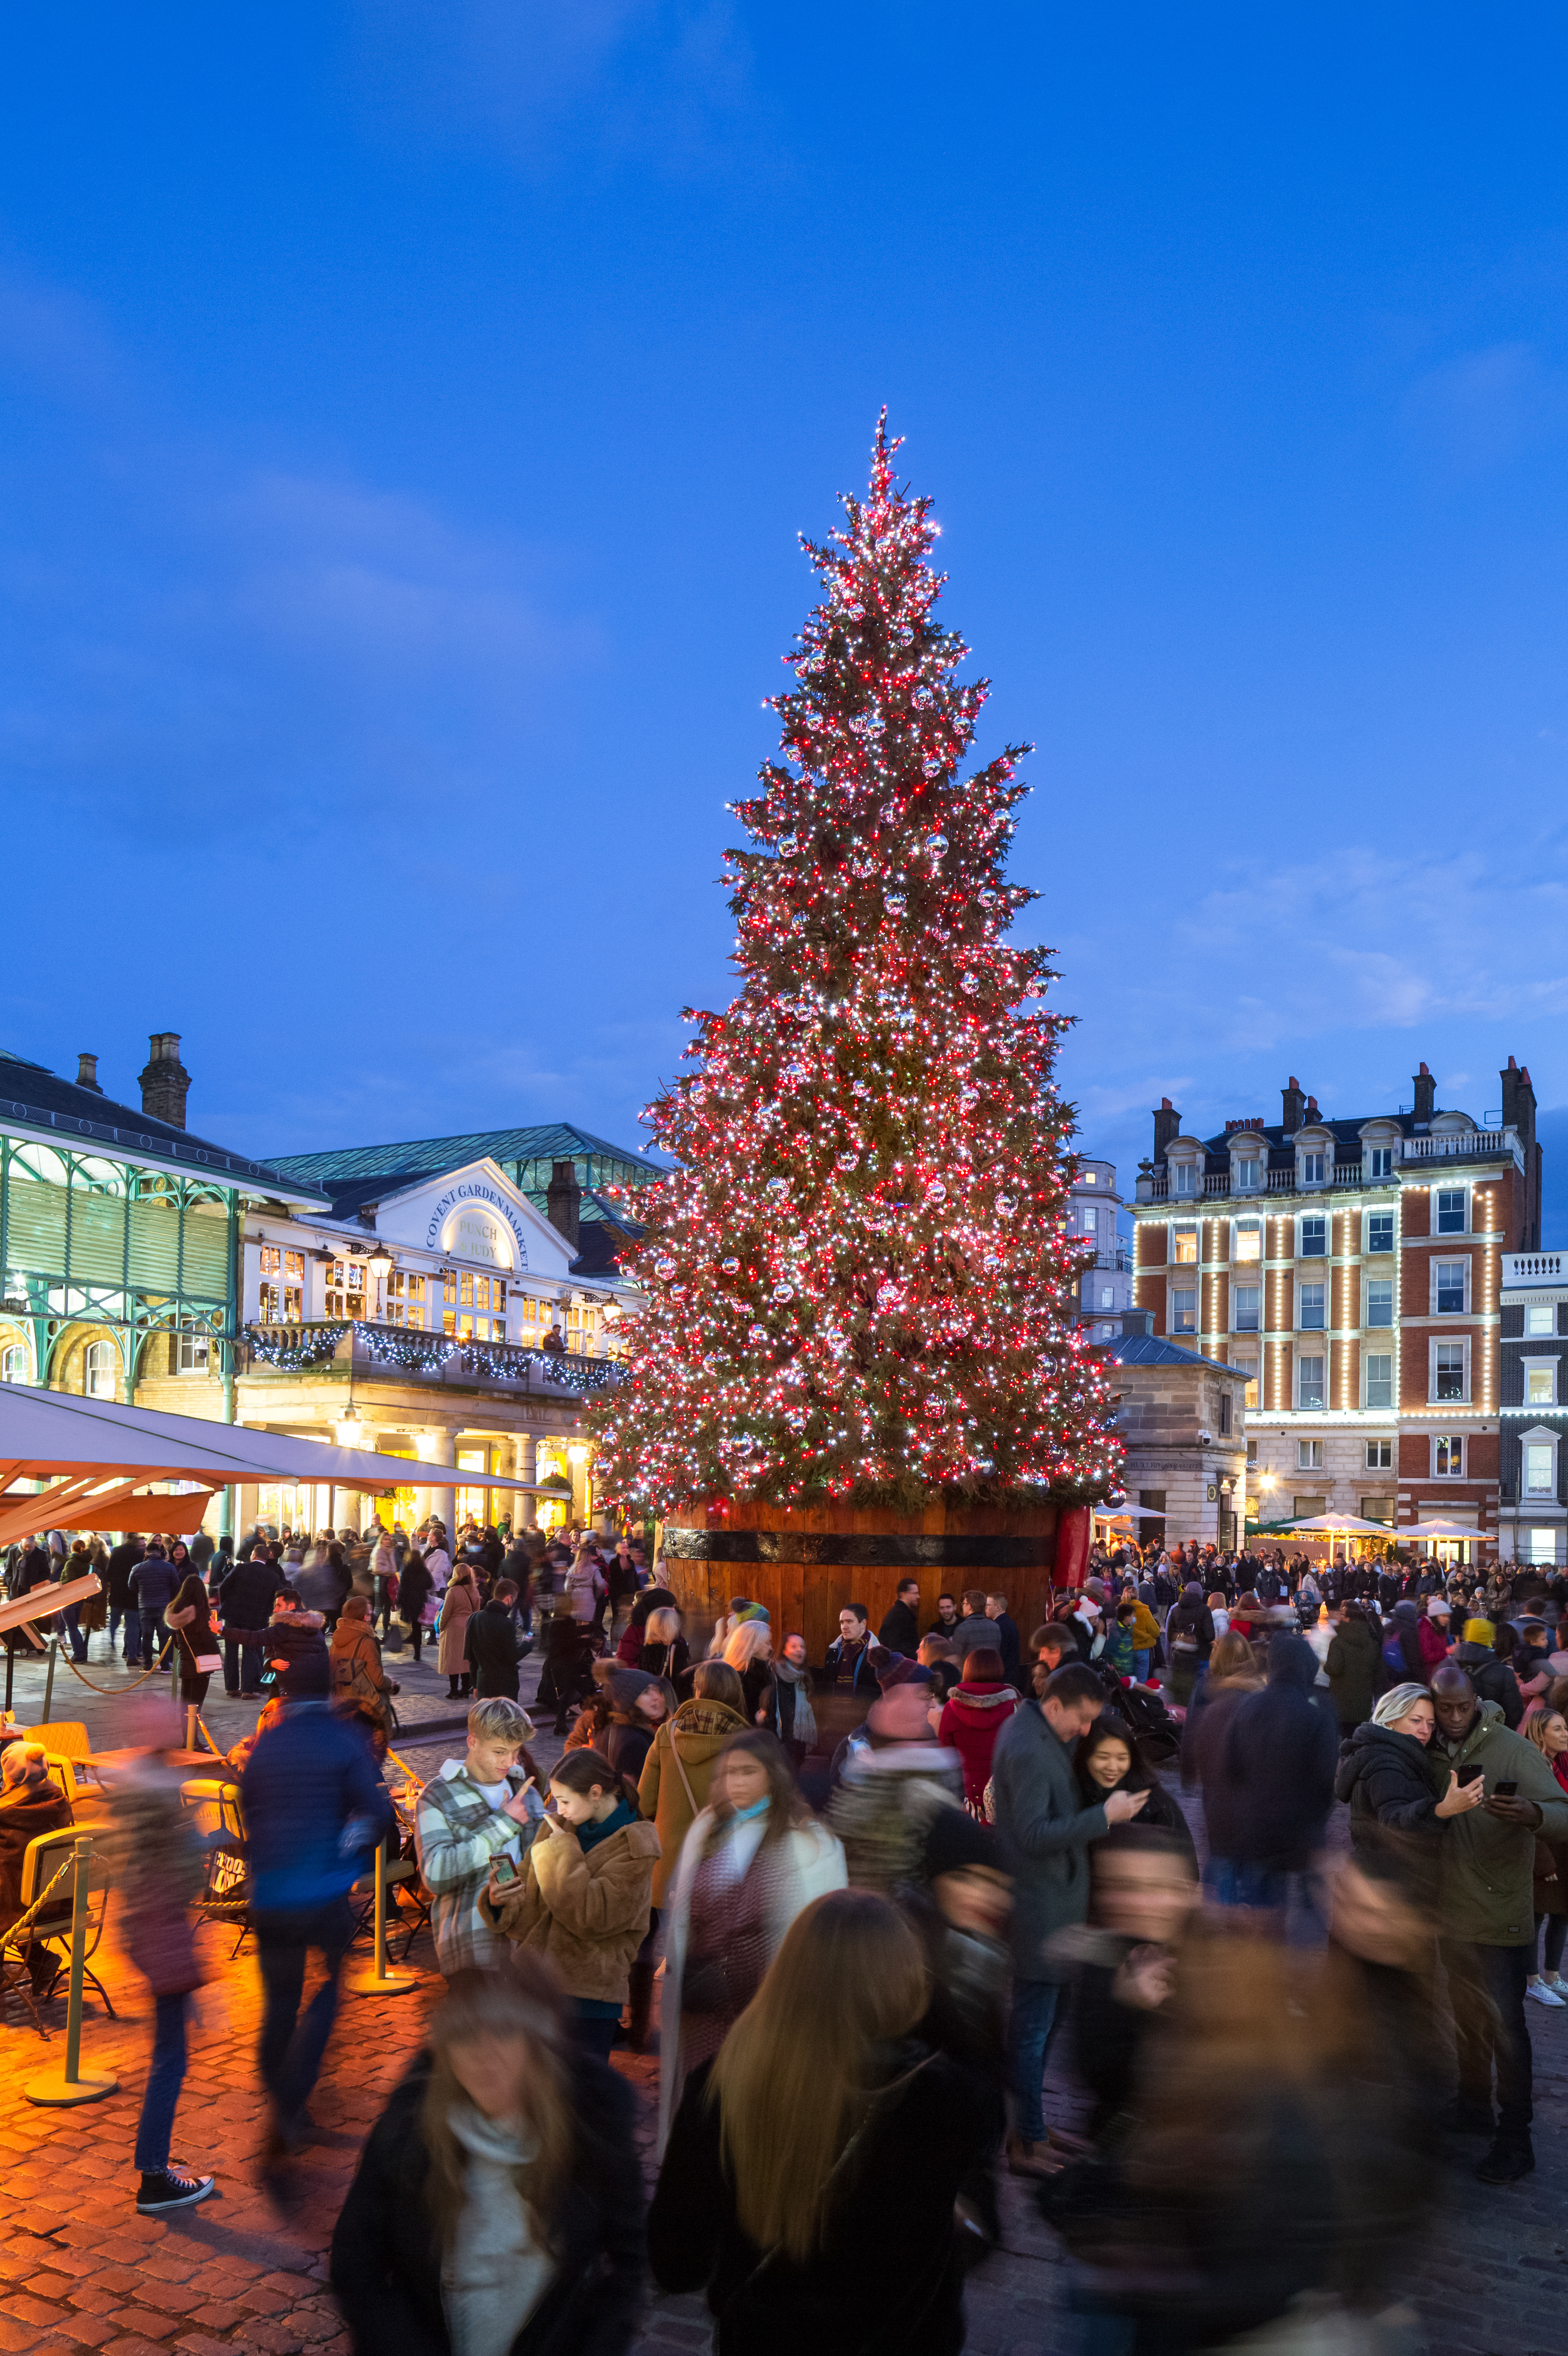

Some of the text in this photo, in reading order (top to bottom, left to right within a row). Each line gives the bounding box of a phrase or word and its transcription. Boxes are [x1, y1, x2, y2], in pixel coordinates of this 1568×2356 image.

[426, 1184, 528, 1270] COVENT GARDEN MARKET
[459, 1220, 497, 1240] PUNCH
[459, 1241, 496, 1259] & JUDY
[214, 1851, 247, 1876] CHOOS
